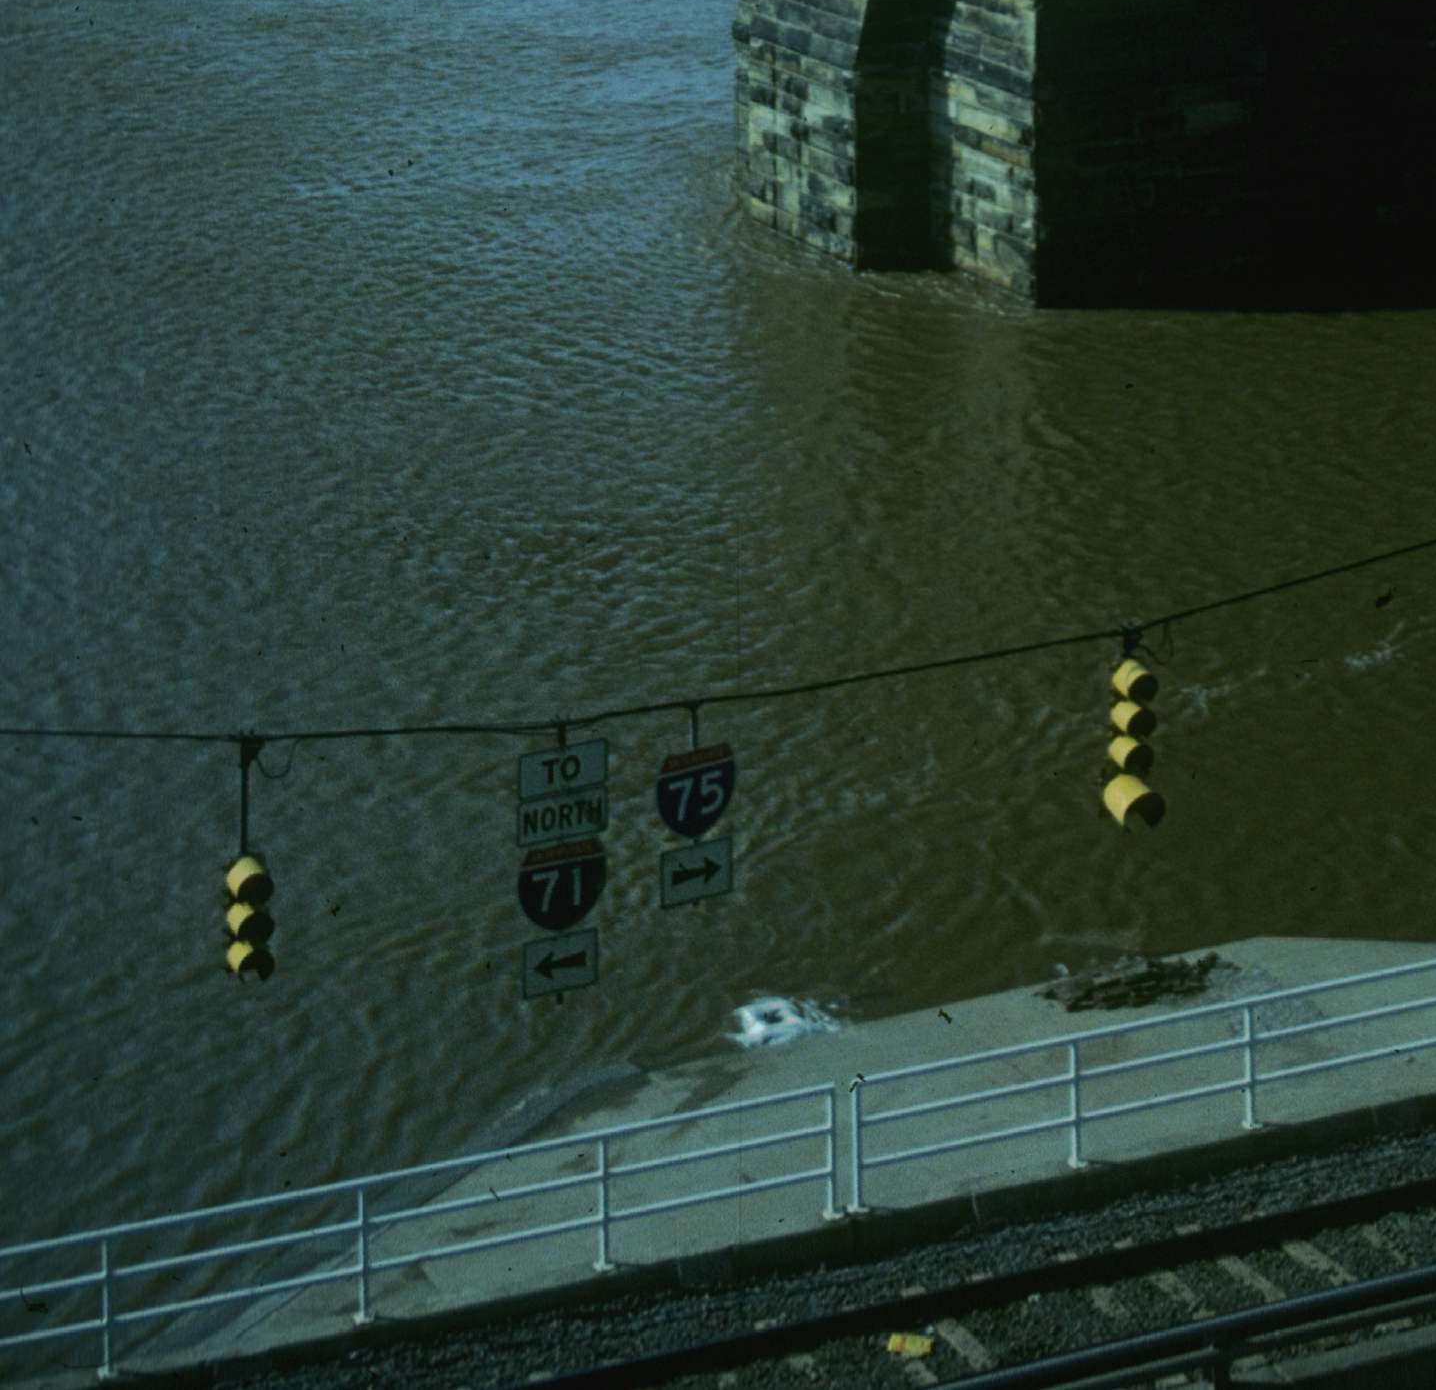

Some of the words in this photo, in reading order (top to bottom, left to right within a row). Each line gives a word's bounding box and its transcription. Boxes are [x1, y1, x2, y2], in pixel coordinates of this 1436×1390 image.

[542, 755, 581, 785] TO
[523, 796, 603, 835] NORTH
[668, 770, 724, 821] 75
[531, 866, 582, 913] 71
